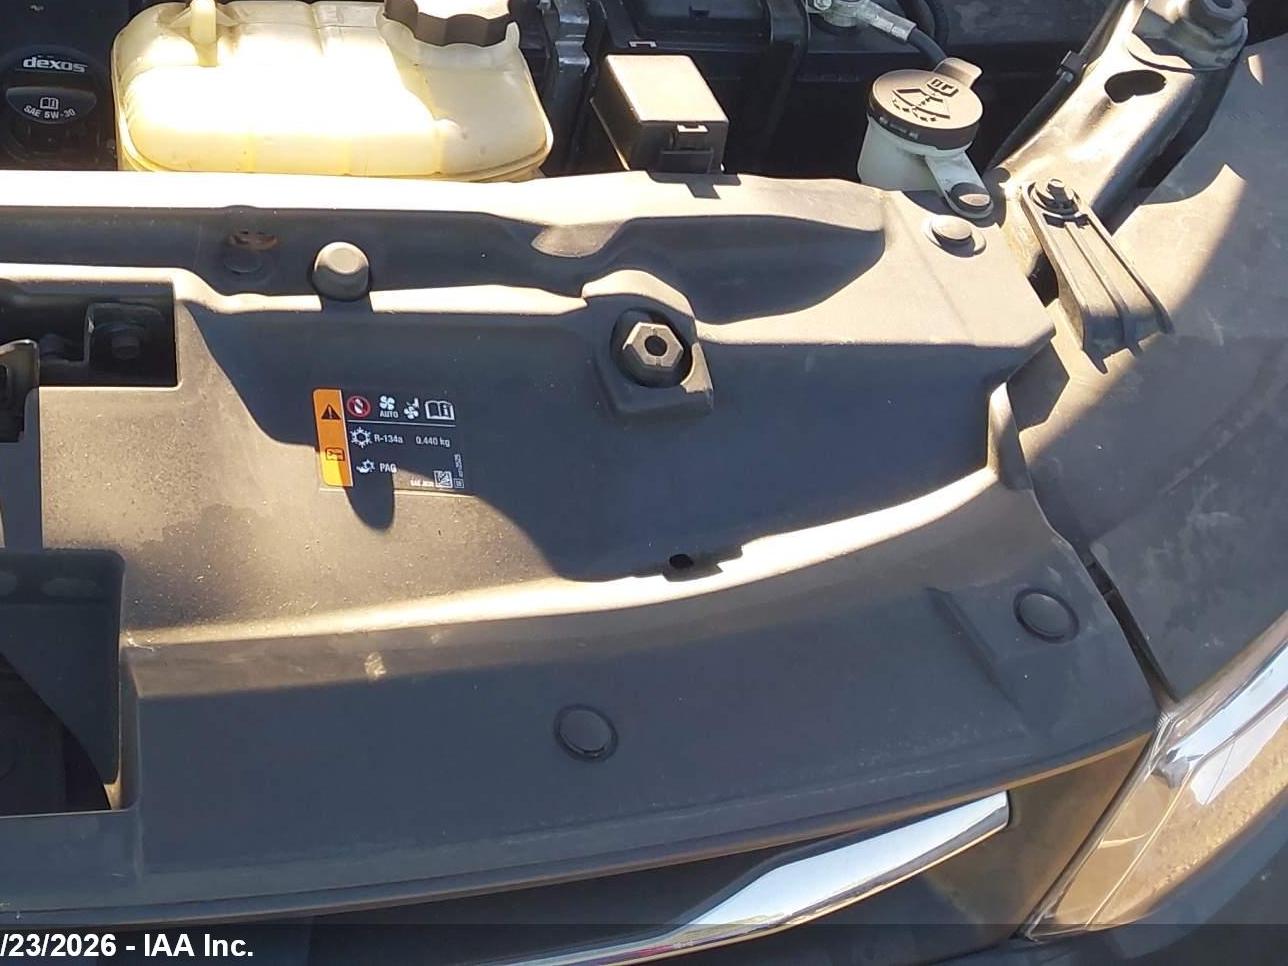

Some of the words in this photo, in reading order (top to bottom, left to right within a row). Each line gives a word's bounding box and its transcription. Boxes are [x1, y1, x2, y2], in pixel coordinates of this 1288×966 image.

[22, 56, 88, 73] dexos
[23, 105, 42, 118] SAE
[44, 108, 76, 119] 5W-30
[379, 409, 399, 419] AUTO
[374, 434, 404, 444] R-134a
[439, 437, 451, 448] kg
[379, 462, 397, 473] PAG
